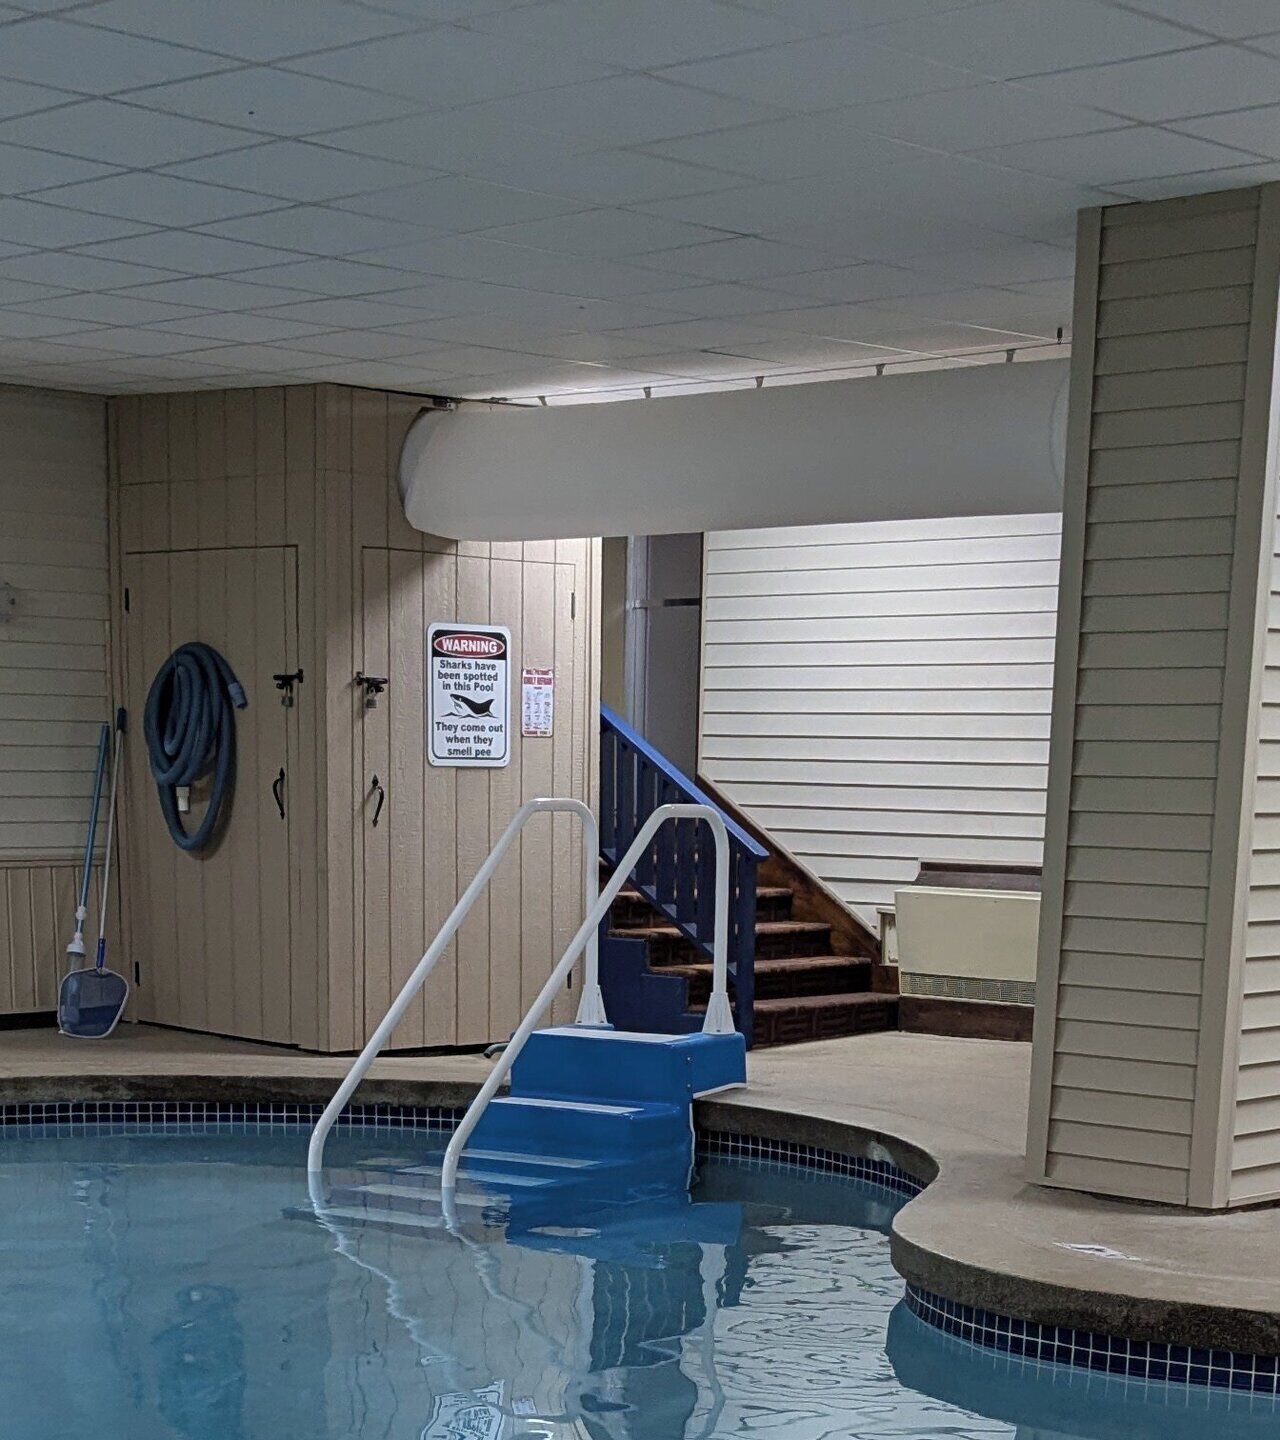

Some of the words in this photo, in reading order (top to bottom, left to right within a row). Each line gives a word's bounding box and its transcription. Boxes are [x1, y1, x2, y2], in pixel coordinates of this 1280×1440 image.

[441, 638, 498, 653] WARNING
[439, 659, 472, 670] Sharks
[474, 661, 497, 671] have
[437, 670, 462, 680] been
[463, 672, 498, 683] spotted
[442, 681, 451, 690] in
[453, 681, 471, 691] this
[473, 682, 494, 692] Pool
[435, 721, 459, 733] They
[460, 724, 486, 732] come
[488, 723, 503, 733] out
[445, 735, 471, 744] when
[473, 735, 494, 747] they
[447, 746, 472, 756] smell
[474, 748, 492, 759] pee
